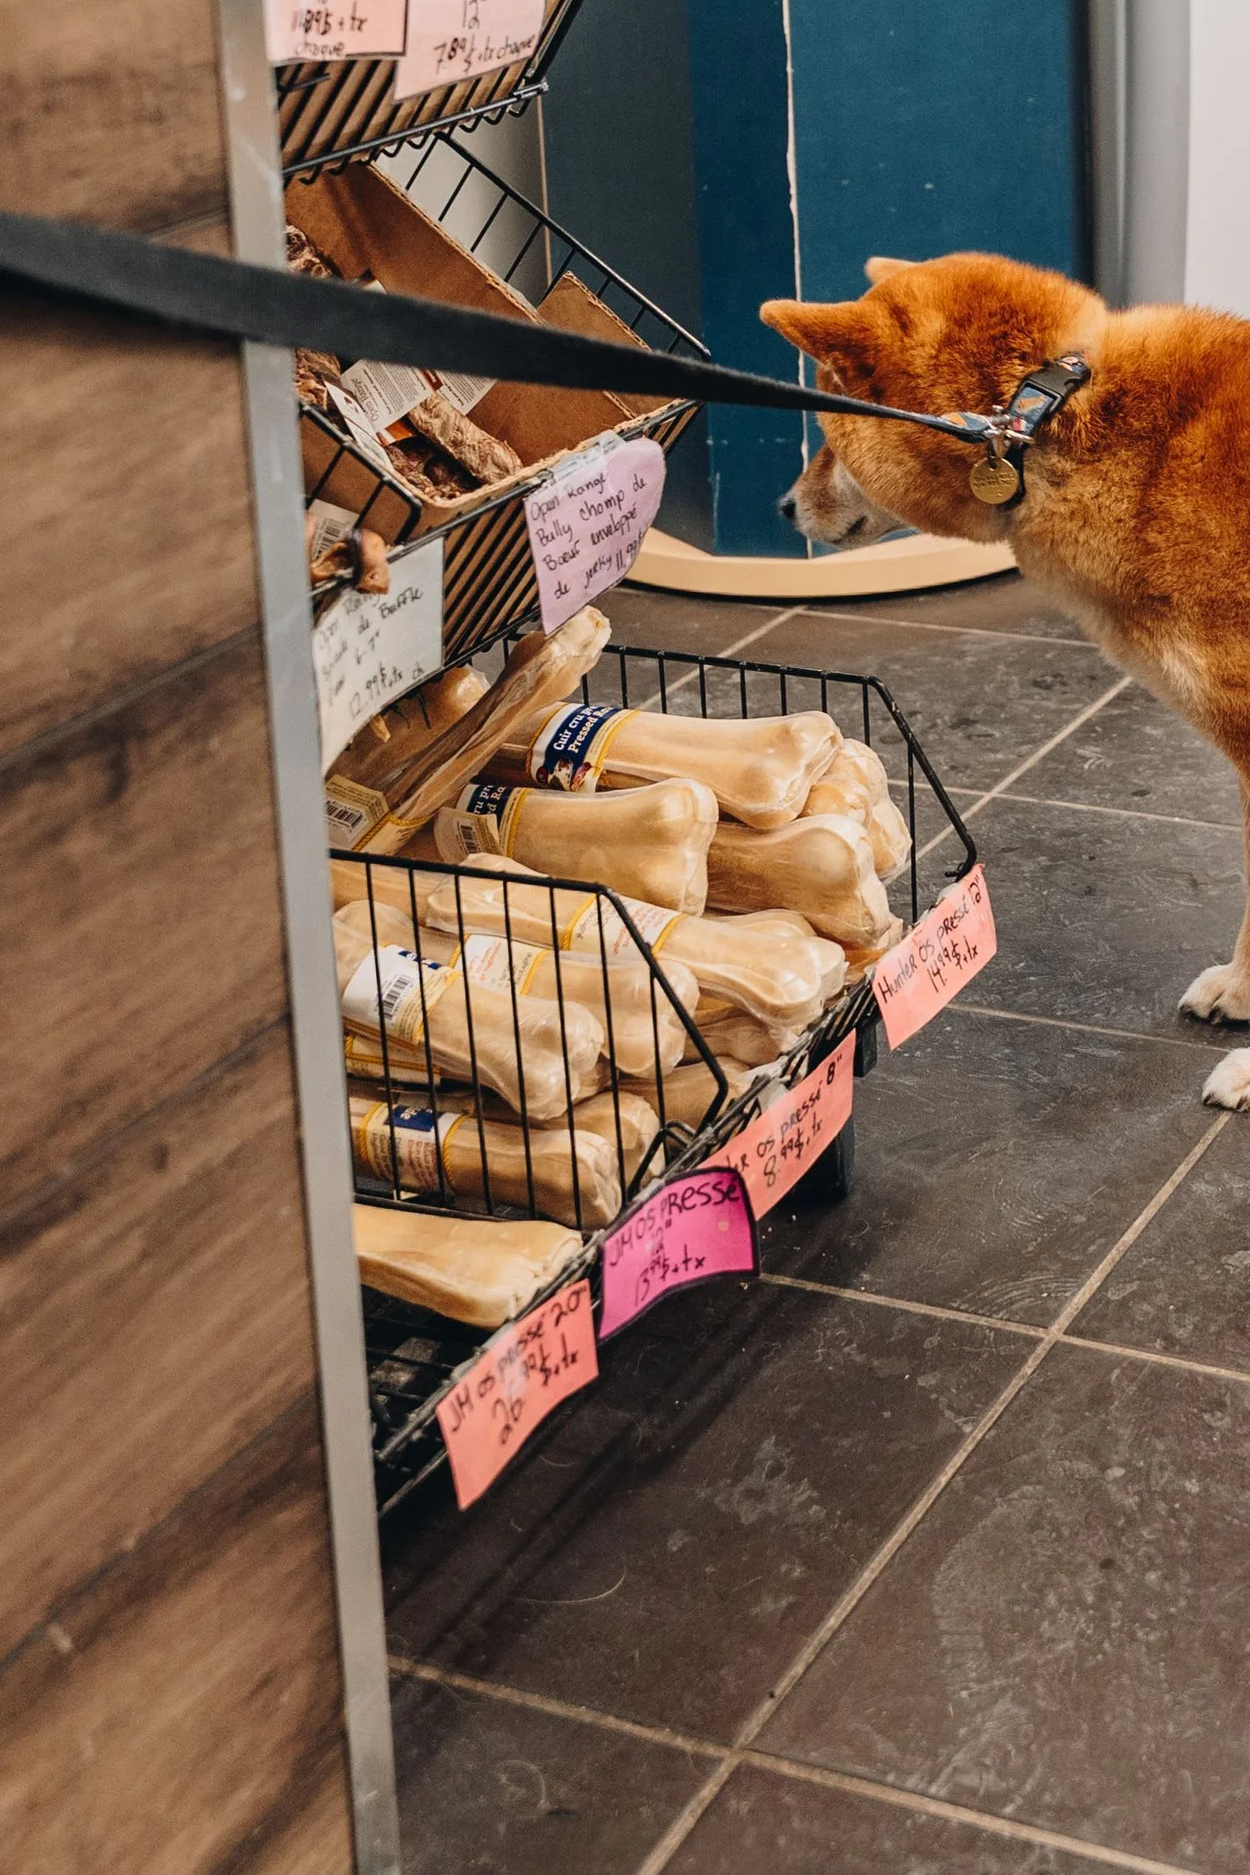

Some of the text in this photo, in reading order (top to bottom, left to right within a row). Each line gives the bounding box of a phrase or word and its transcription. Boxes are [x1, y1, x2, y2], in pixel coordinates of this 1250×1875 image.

[531, 495, 561, 523] Open
[536, 519, 574, 547] Bully
[579, 489, 626, 521] chomp
[553, 728, 573, 751] Cuir
[568, 712, 585, 729] cru
[567, 715, 600, 754] Pressed
